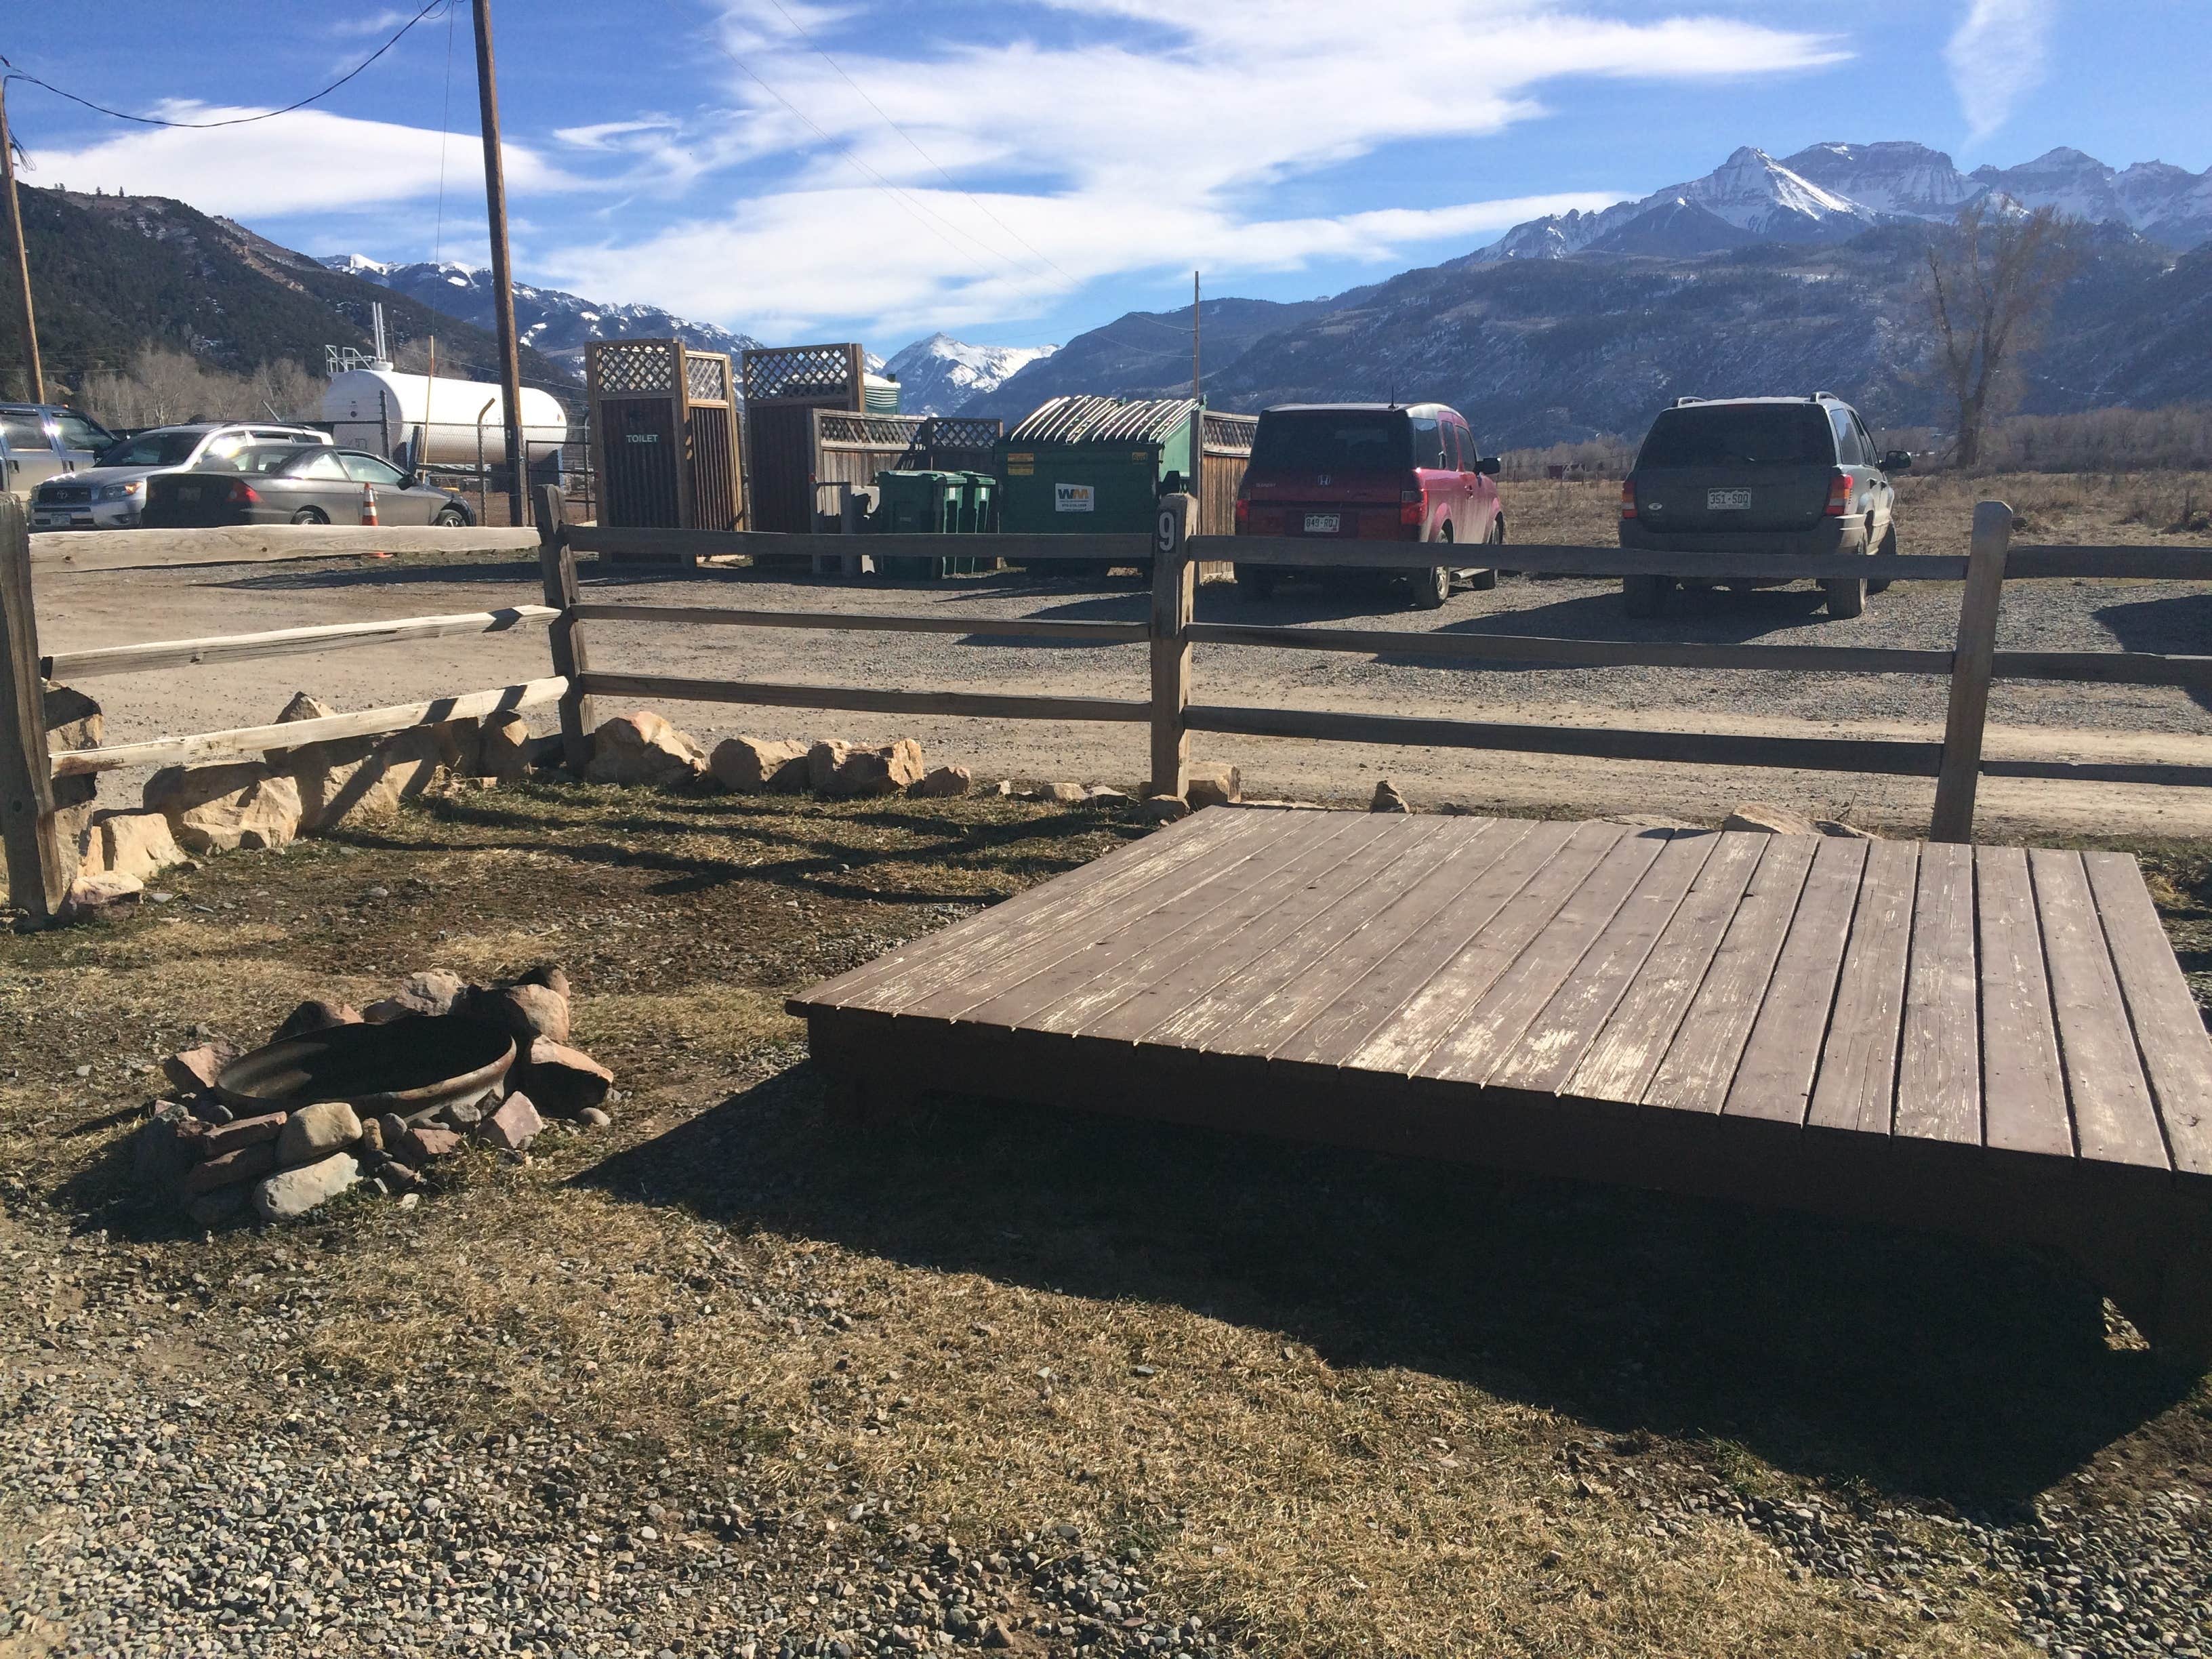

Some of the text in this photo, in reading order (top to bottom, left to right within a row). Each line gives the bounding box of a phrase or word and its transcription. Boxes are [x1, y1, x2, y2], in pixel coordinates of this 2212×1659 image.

[626, 434, 658, 443] TOILET
[1058, 489, 1088, 499] WM
[1159, 512, 1174, 552] 9
